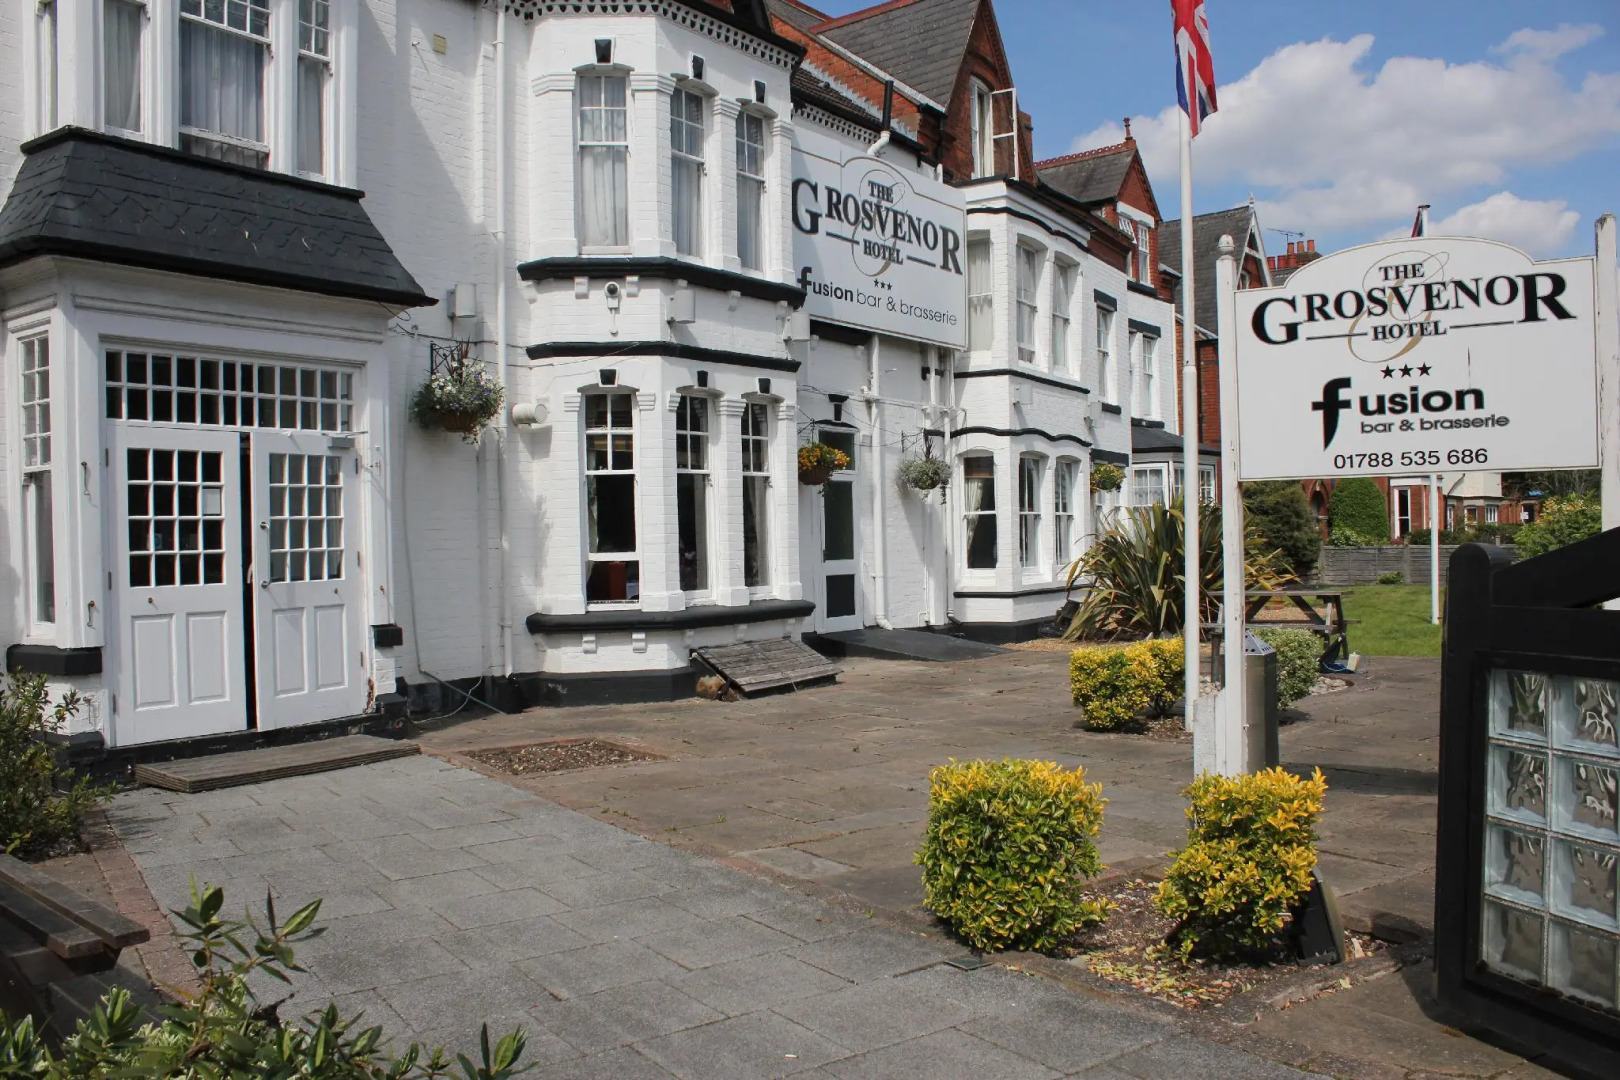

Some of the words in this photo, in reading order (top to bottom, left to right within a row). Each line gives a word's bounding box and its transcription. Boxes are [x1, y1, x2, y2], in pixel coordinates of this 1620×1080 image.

[867, 180, 894, 204] THE
[791, 178, 963, 275] GROSVENOR
[862, 239, 904, 265] HOTEL
[1378, 263, 1425, 281] THE
[797, 266, 854, 302] fusion
[856, 288, 881, 309] bar
[886, 296, 897, 312] &
[900, 301, 957, 326] brasserie
[1251, 272, 1577, 345] GROSVENOR
[1371, 319, 1447, 341] HOTEL
[1311, 377, 1485, 452] fusion
[1361, 421, 1393, 434] bar
[1399, 419, 1415, 432] &
[1420, 414, 1510, 431] brasserie
[1333, 452, 1393, 469] 01788
[1400, 450, 1440, 466] 535
[1447, 448, 1488, 464] 686
